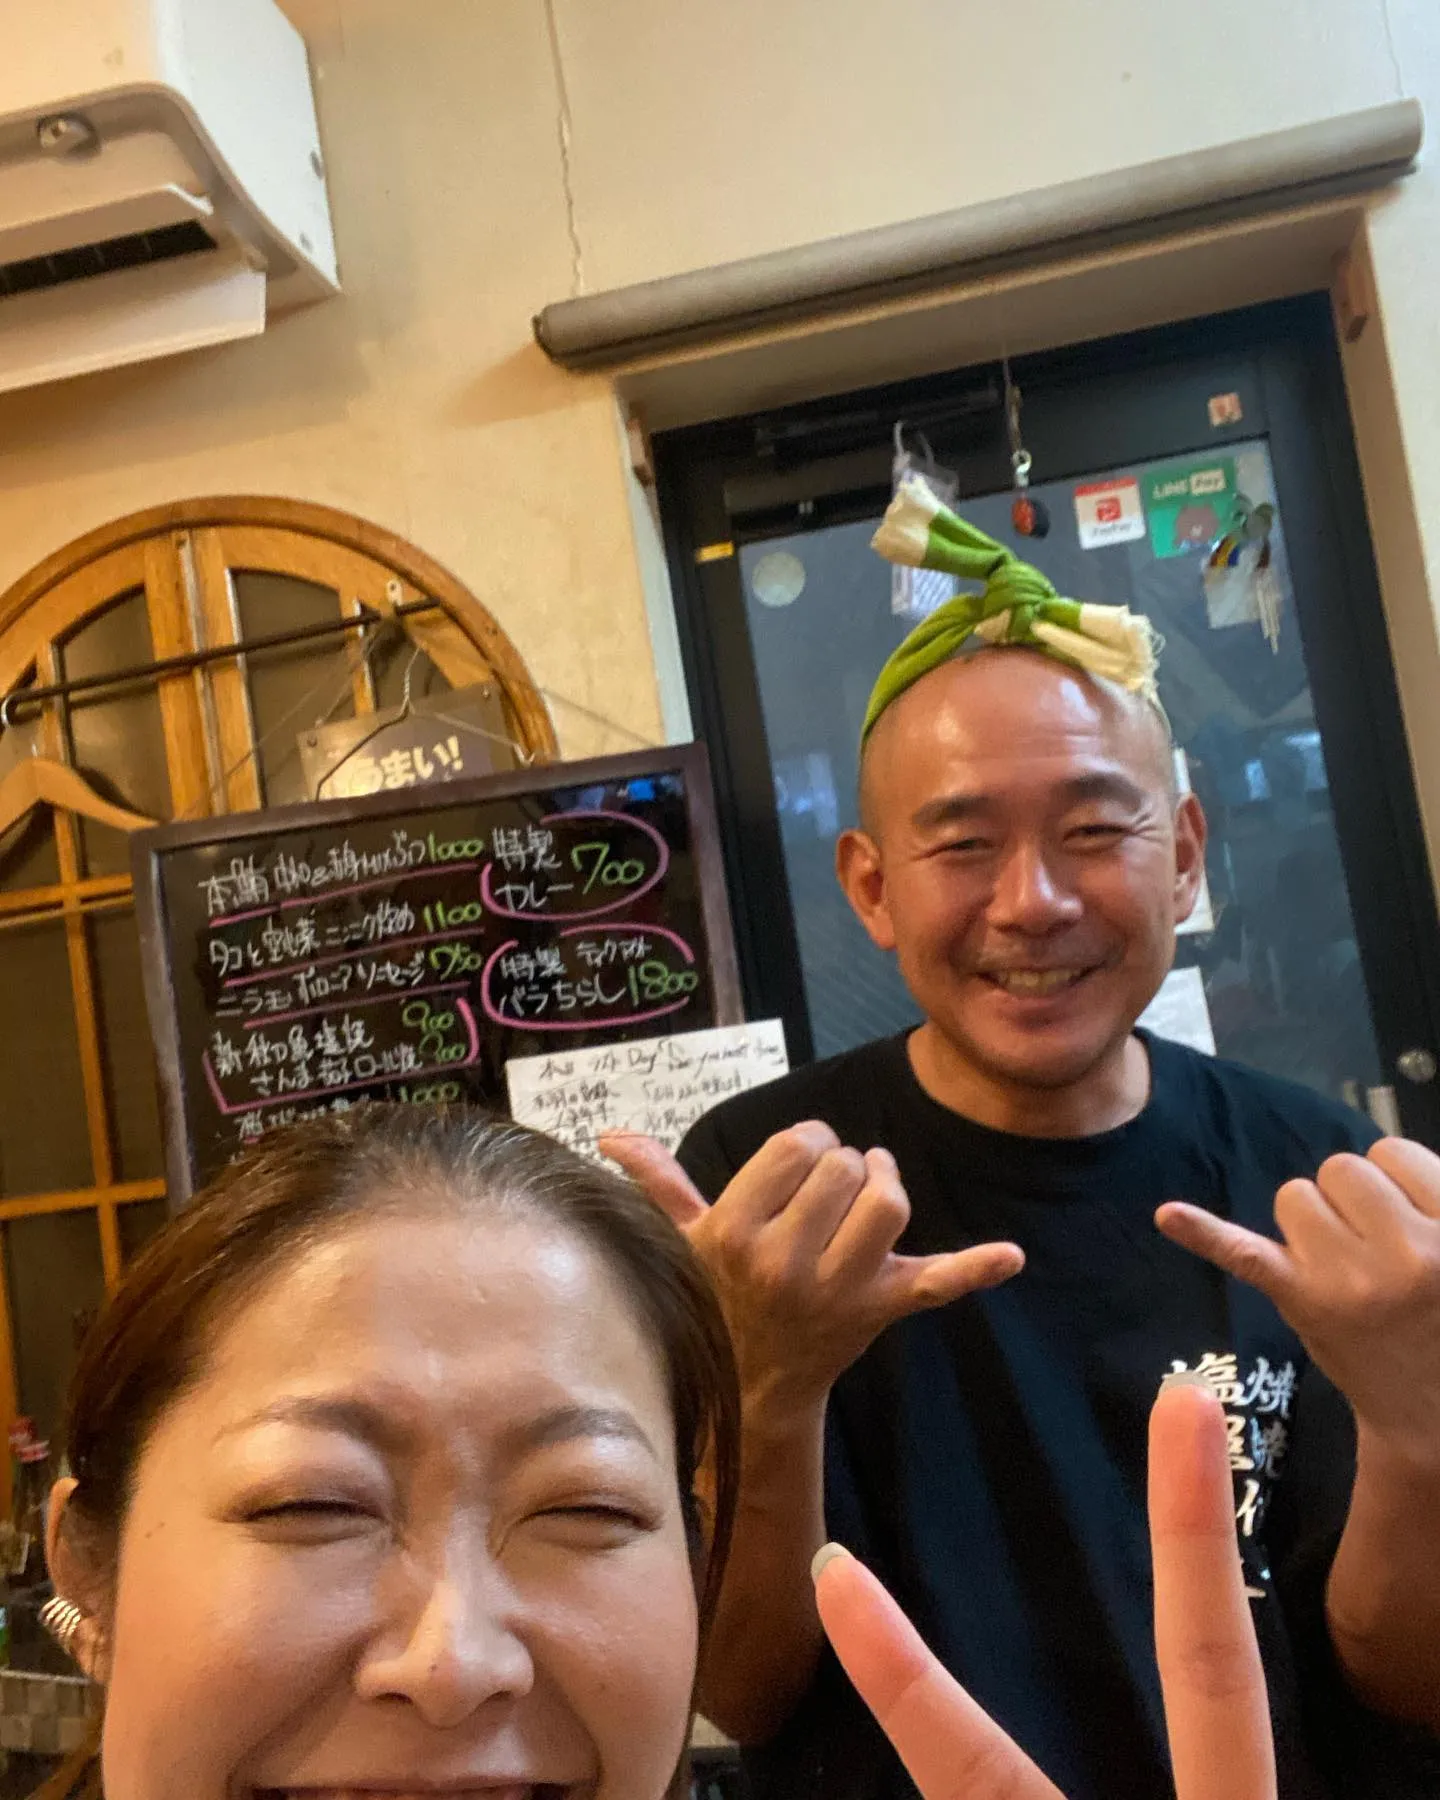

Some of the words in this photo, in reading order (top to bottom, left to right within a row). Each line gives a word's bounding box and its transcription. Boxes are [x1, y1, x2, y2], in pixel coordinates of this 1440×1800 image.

[1151, 478, 1190, 500] LINE
[427, 831, 484, 863] 1000
[491, 823, 563, 873] 特製
[570, 841, 646, 896] 700
[494, 880, 575, 913] カレー
[423, 900, 482, 934] 1100
[429, 942, 482, 981] 750
[500, 946, 568, 982] 特製
[499, 973, 627, 1017] バラちらし
[627, 960, 699, 1008] 1800
[402, 999, 455, 1034] 900
[418, 1030, 467, 1064] 900
